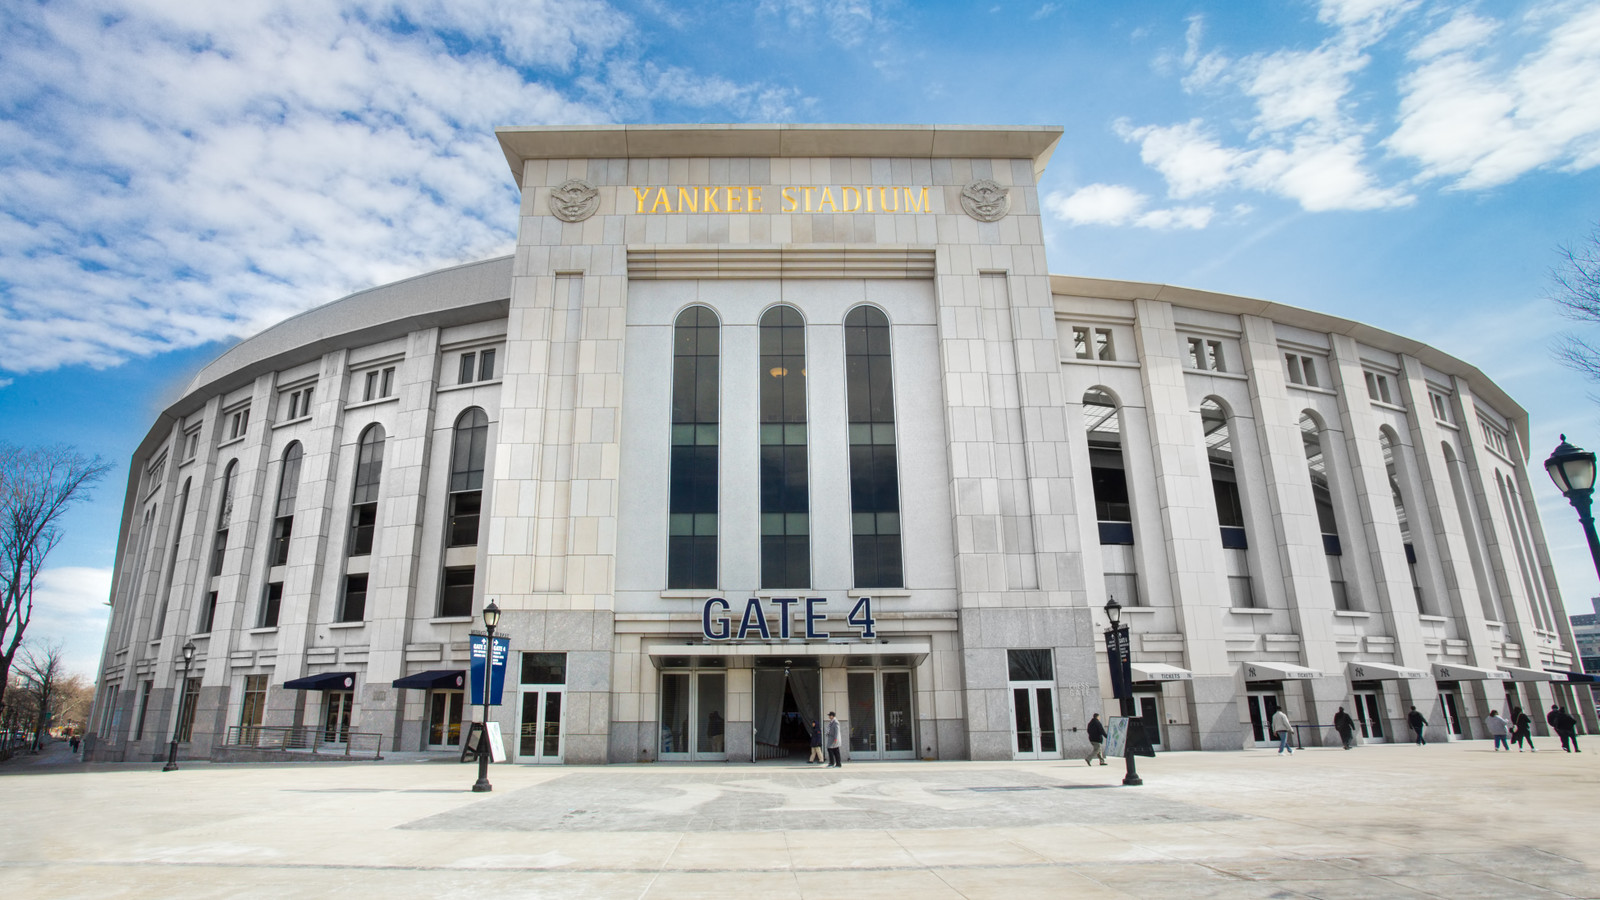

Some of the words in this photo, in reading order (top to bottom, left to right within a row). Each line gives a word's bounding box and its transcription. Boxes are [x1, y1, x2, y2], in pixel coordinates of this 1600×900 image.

[632, 186, 763, 213] YANKEE
[781, 186, 933, 213] STADIUM
[702, 597, 830, 640] GATE
[846, 596, 877, 640] 4
